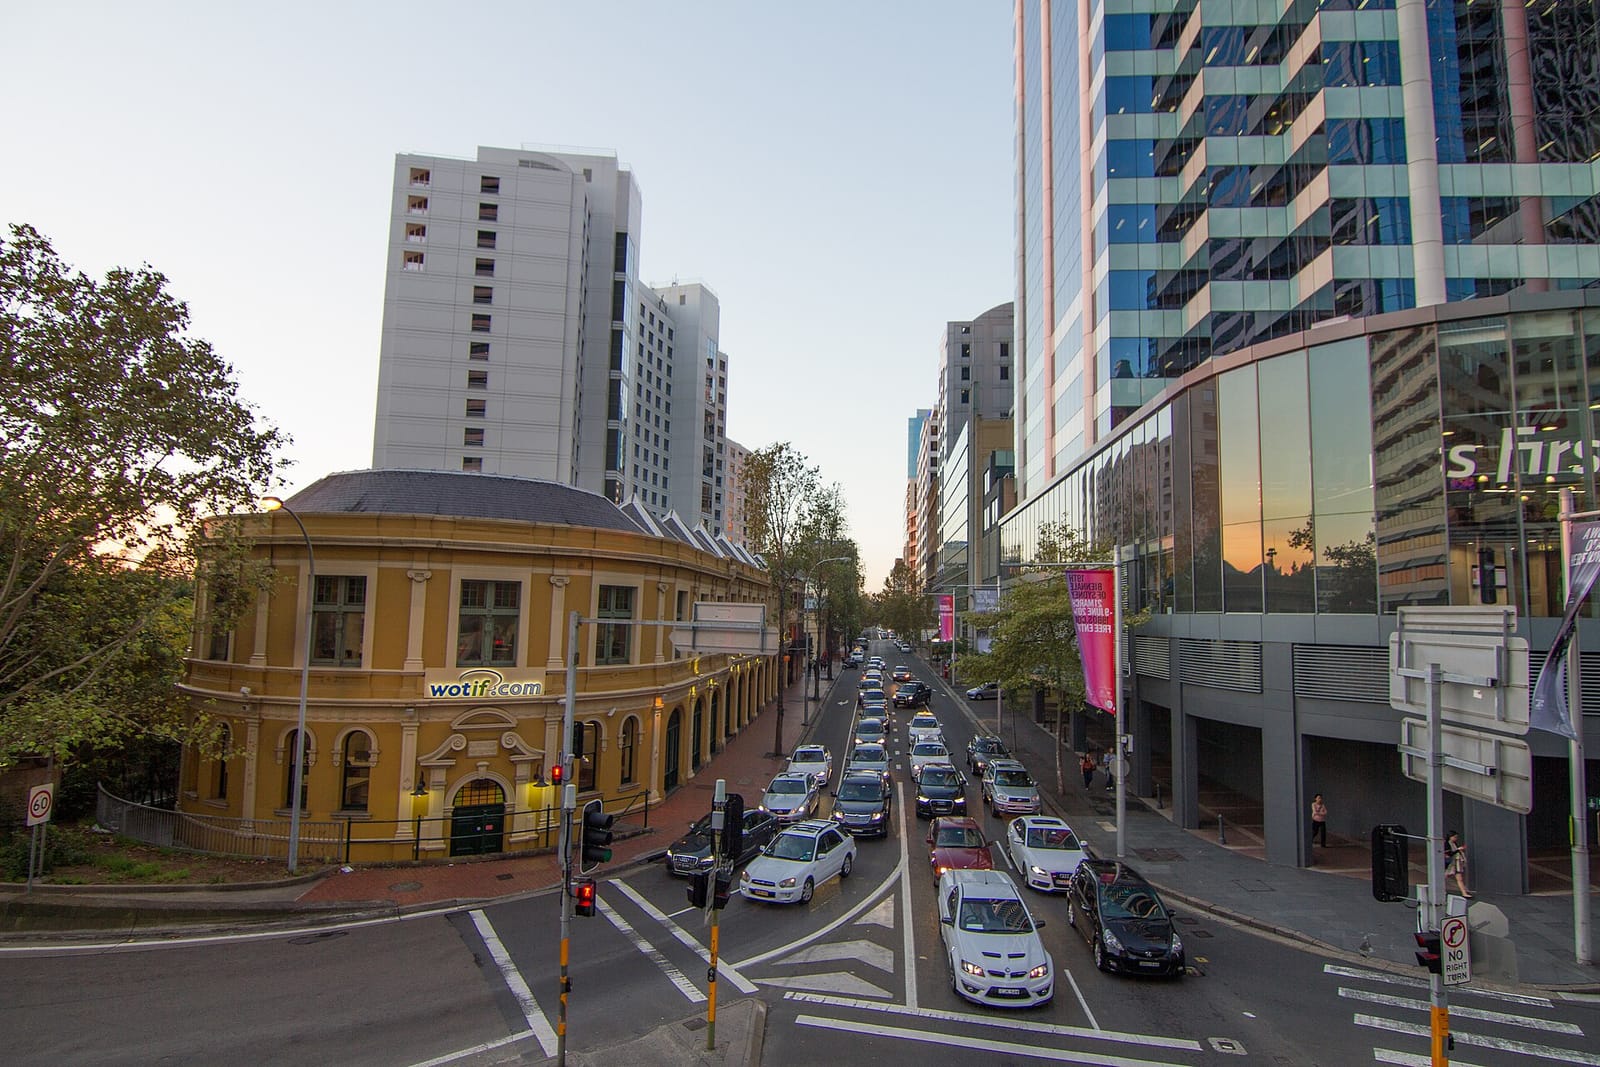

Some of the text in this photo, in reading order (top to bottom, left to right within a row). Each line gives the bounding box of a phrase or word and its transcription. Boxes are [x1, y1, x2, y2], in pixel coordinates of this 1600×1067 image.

[430, 679, 542, 697] wotif.com
[33, 797, 48, 811] 60
[1448, 949, 1463, 961] NO
[1446, 962, 1467, 972] RIGHT
[1447, 972, 1467, 982] TURN
